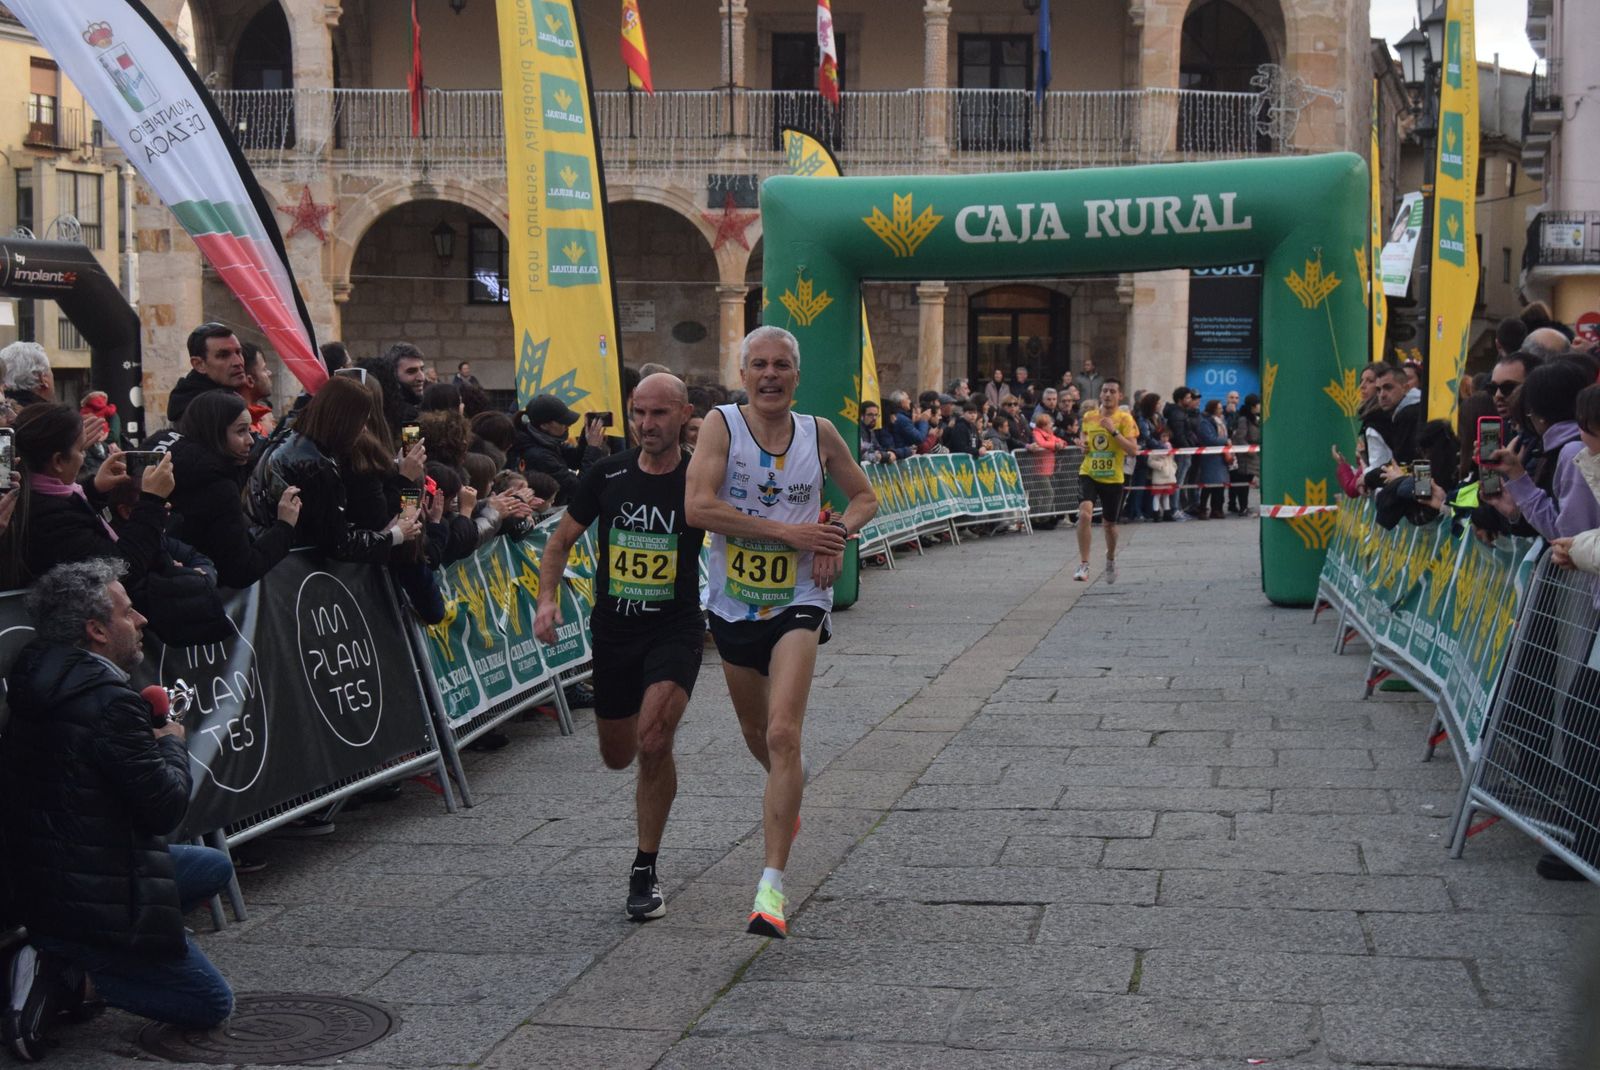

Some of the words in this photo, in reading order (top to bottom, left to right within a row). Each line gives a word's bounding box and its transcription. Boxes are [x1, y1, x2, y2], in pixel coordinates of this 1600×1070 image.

[955, 202, 1070, 244] CAJA
[1084, 192, 1252, 238] RURAL
[1204, 368, 1237, 386] 016
[1091, 459, 1113, 470] 839
[620, 501, 676, 534] SAN
[615, 550, 669, 580] 452
[731, 550, 788, 584] 430
[624, 586, 644, 595] CAJA
[645, 587, 671, 596] RURAL
[741, 589, 760, 600] CAJA
[761, 592, 790, 601] RURAL
[311, 603, 349, 636] IM
[309, 638, 371, 680] PLAN
[194, 667, 256, 715] LAN
[329, 679, 373, 715] TES
[201, 714, 255, 756] TES
